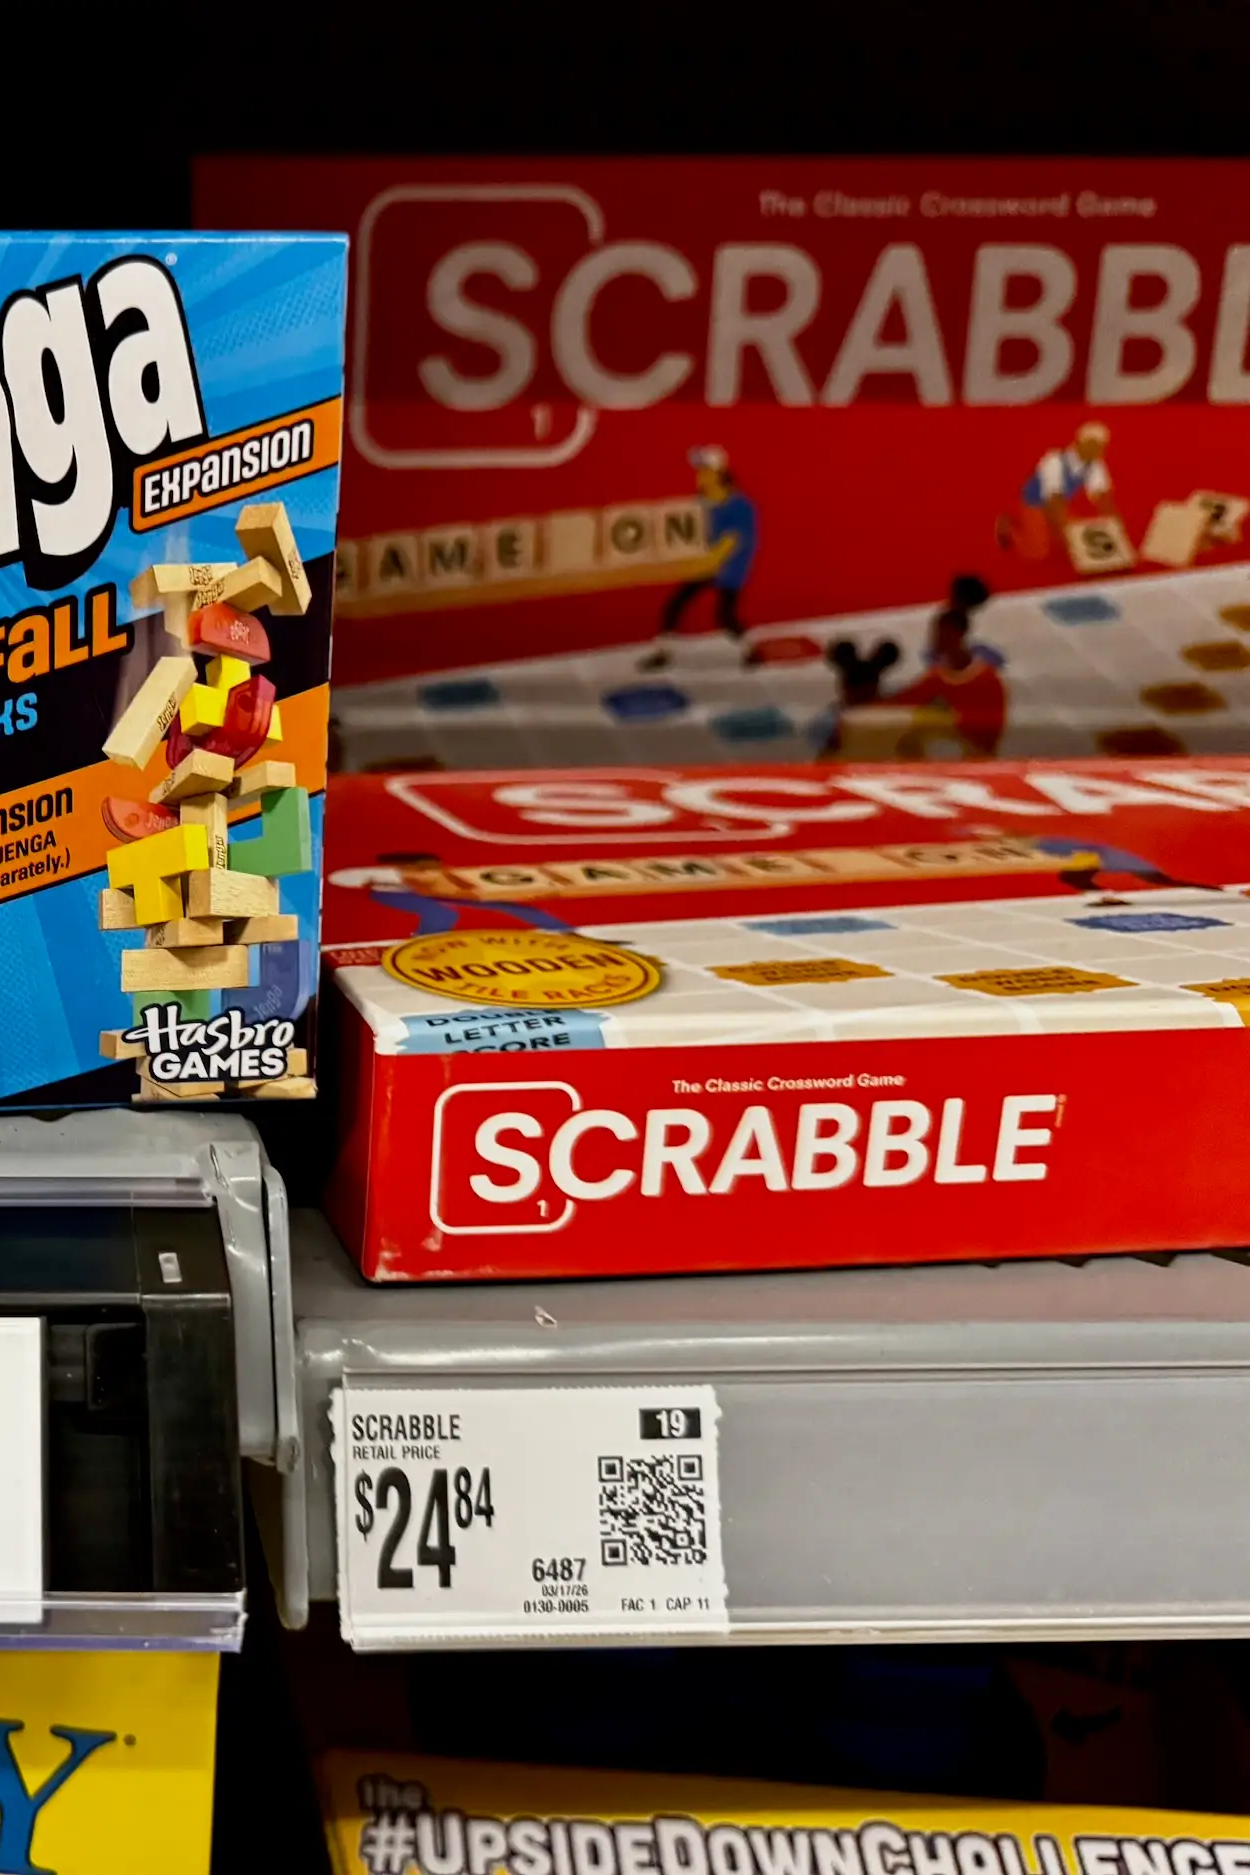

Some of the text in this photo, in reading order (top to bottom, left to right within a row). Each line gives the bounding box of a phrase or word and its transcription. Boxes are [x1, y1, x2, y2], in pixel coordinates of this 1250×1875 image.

[610, 511, 697, 555] ON
[412, 952, 625, 983] WOODEN
[124, 1005, 295, 1056] Hasbro
[444, 1016, 566, 1045] LETTER
[152, 1048, 286, 1081] GAMES
[672, 1073, 905, 1094] The Classic Crossword Game
[469, 1094, 1058, 1204] SCRABBLE
[536, 1199, 549, 1218] 1
[351, 1413, 462, 1442] SCRABBLE
[655, 1409, 687, 1438] 19
[352, 1445, 441, 1460] RETAIL PRICE
[531, 1558, 587, 1583] 6487
[541, 1584, 589, 1598] 03/17/26
[620, 1597, 711, 1612] FAC 1 CAP 11
[523, 1599, 590, 1614] 0130-0005
